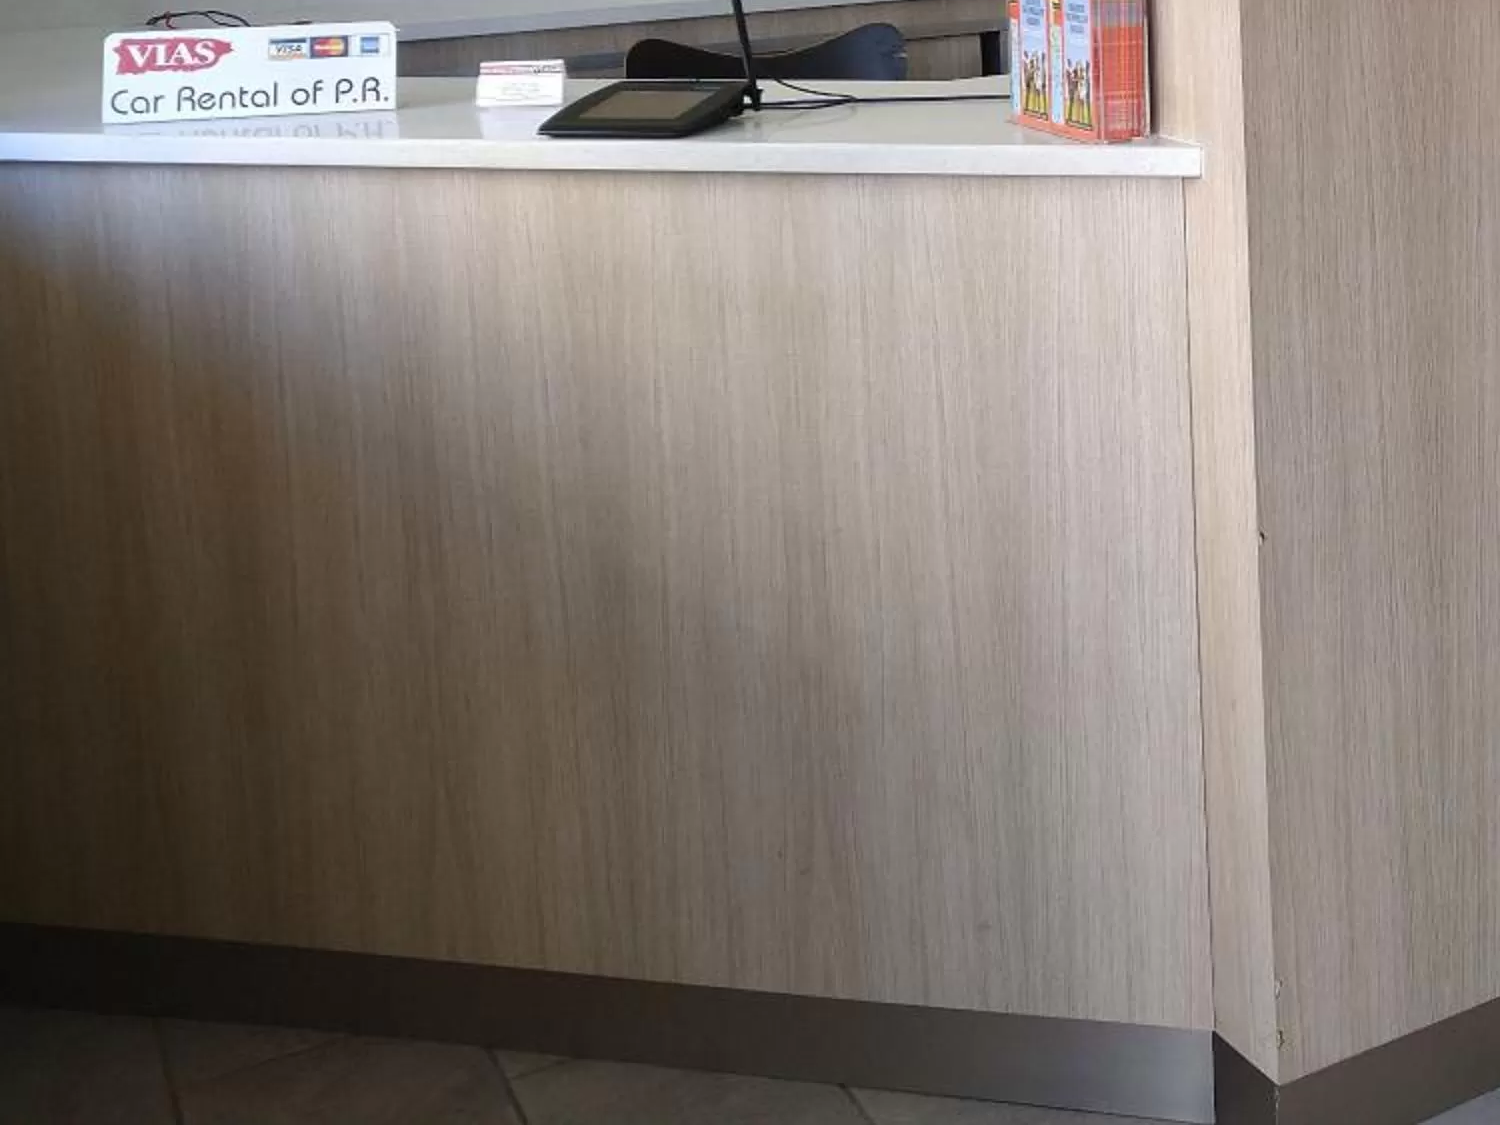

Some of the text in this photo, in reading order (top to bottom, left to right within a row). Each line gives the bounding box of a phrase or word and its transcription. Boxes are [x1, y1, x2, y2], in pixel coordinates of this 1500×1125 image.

[126, 40, 216, 68] VIAS
[111, 76, 389, 115] Car Rental of P.R.
